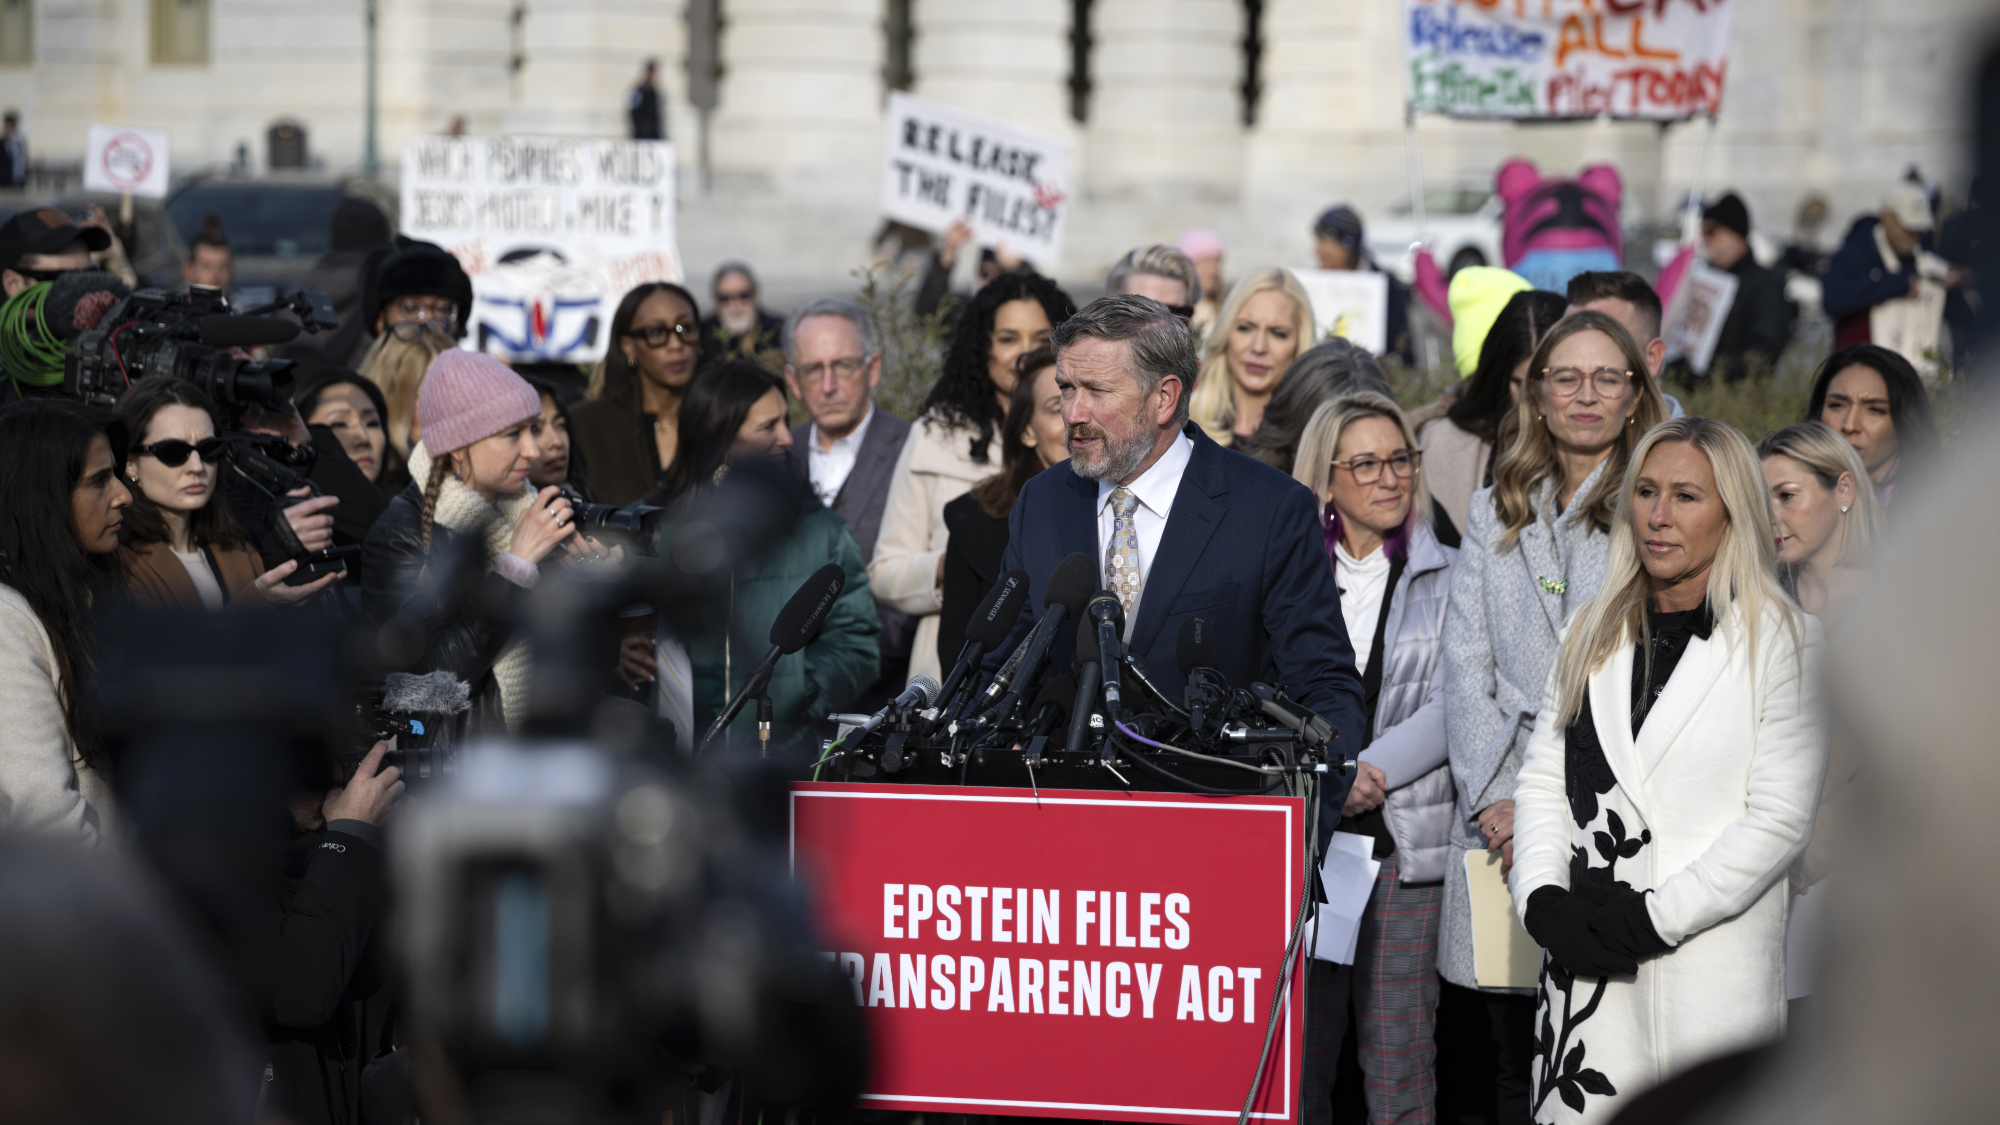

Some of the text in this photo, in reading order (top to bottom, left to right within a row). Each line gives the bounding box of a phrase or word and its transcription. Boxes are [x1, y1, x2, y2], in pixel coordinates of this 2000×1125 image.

[1411, 6, 1682, 68] Release ALL
[903, 118, 1040, 184] RELEASE
[893, 158, 951, 208] THE
[800, 593, 831, 634] SENNHEISER
[987, 587, 1011, 621] SENNHEISER
[883, 883, 1191, 950] EPSTEIN FILES
[1176, 965, 1262, 1024] ACT
